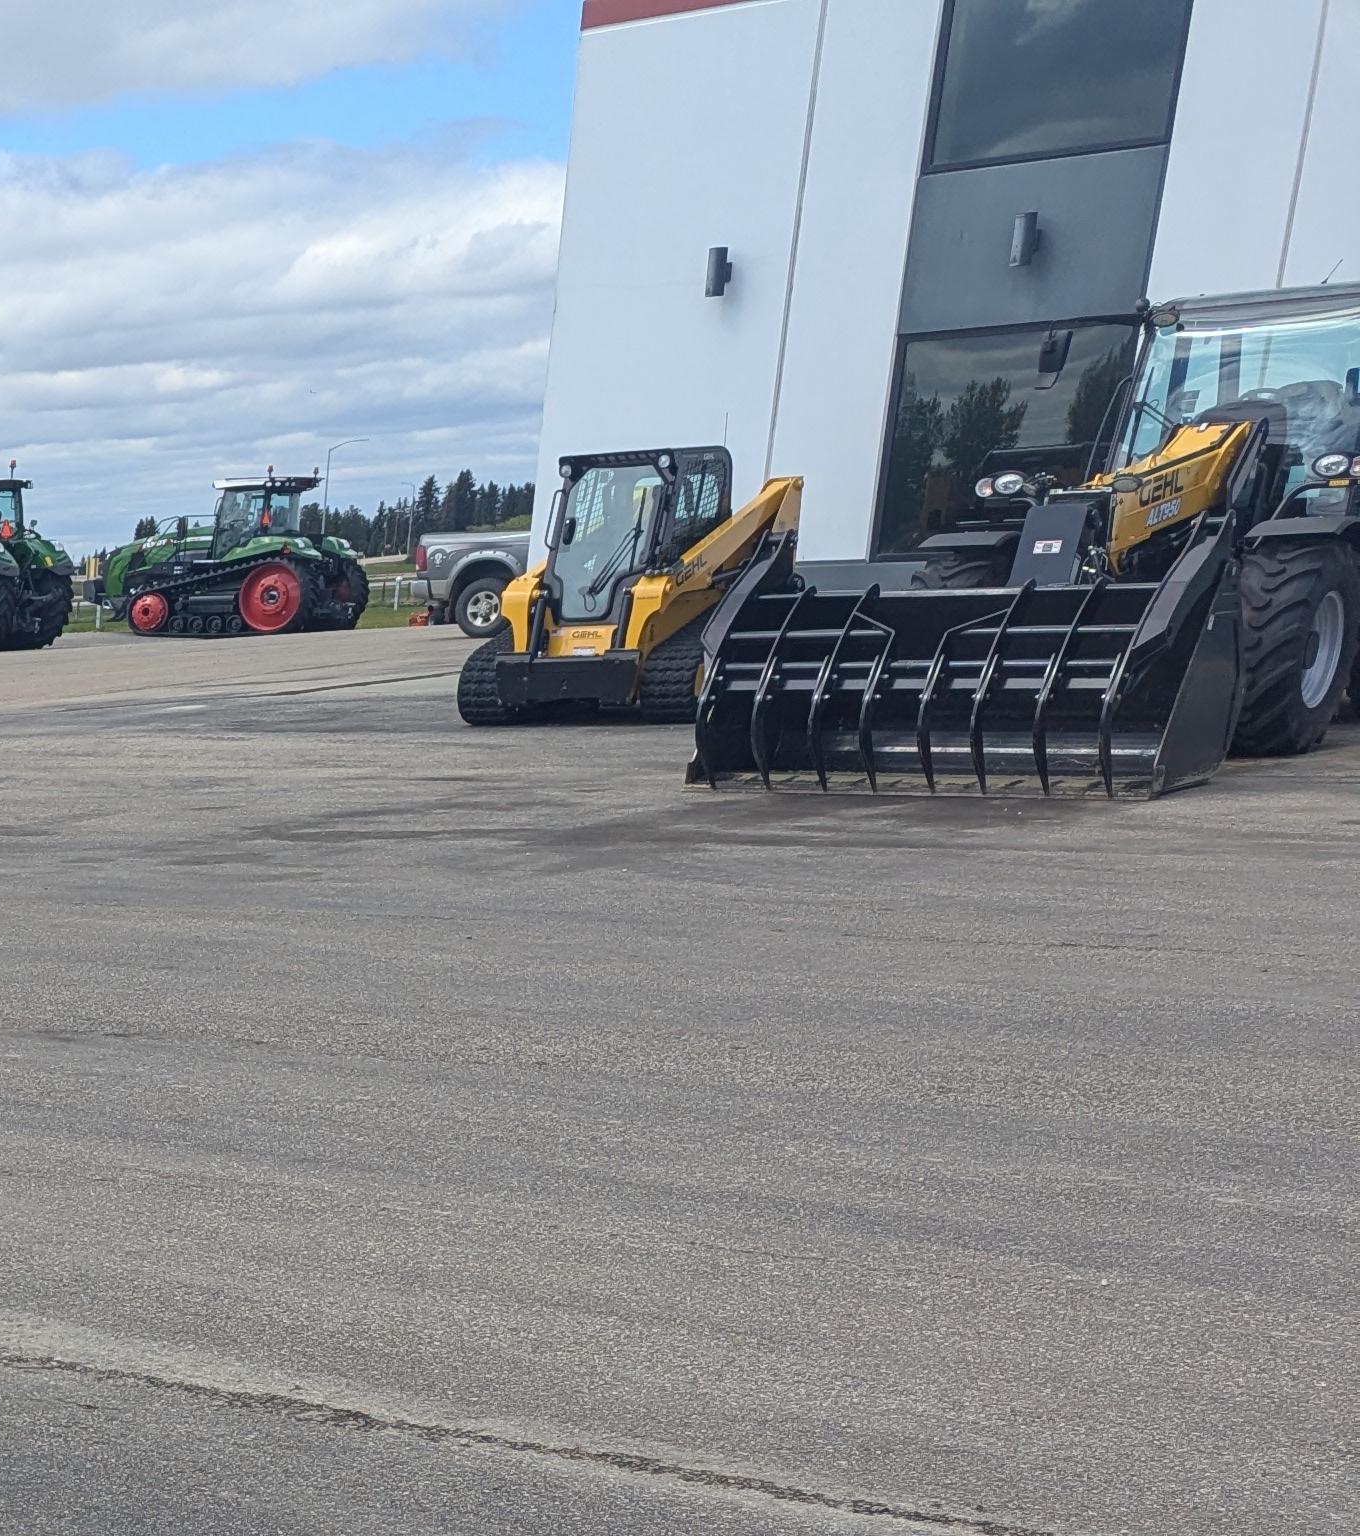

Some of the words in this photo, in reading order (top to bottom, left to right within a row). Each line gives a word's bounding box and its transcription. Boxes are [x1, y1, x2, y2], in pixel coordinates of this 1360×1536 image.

[1139, 468, 1184, 507] GEHL
[1146, 498, 1182, 527] ALT950
[675, 553, 708, 588] GEHL
[571, 630, 602, 640] GEHL
